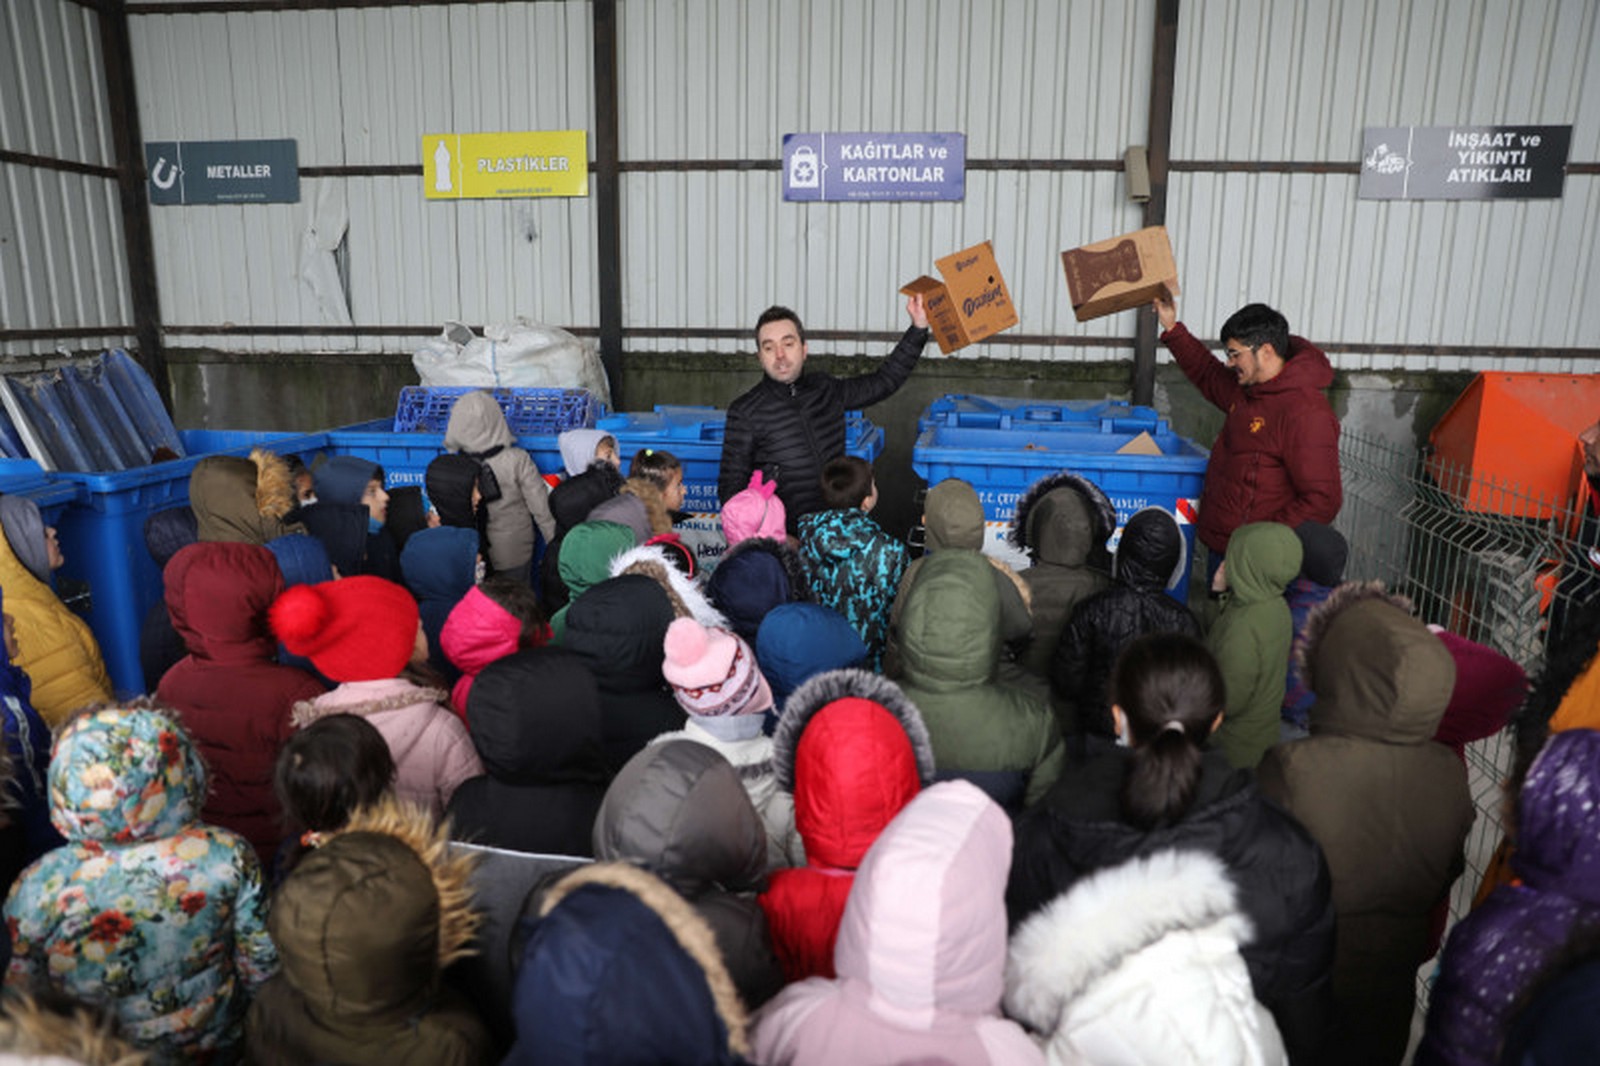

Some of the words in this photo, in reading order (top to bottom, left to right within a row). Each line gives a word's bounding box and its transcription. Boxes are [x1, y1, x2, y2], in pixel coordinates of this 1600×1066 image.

[1448, 130, 1516, 149] İNŞAAT
[1520, 135, 1542, 147] ve
[841, 141, 924, 160] KAĞITLAR
[929, 147, 948, 159] ve
[1458, 150, 1528, 165] YIKINTI
[477, 154, 569, 172] PLASTİKLER
[206, 164, 271, 178] METALLER
[843, 167, 945, 182] KARTONLAR
[1447, 168, 1532, 183] ATIKLARI
